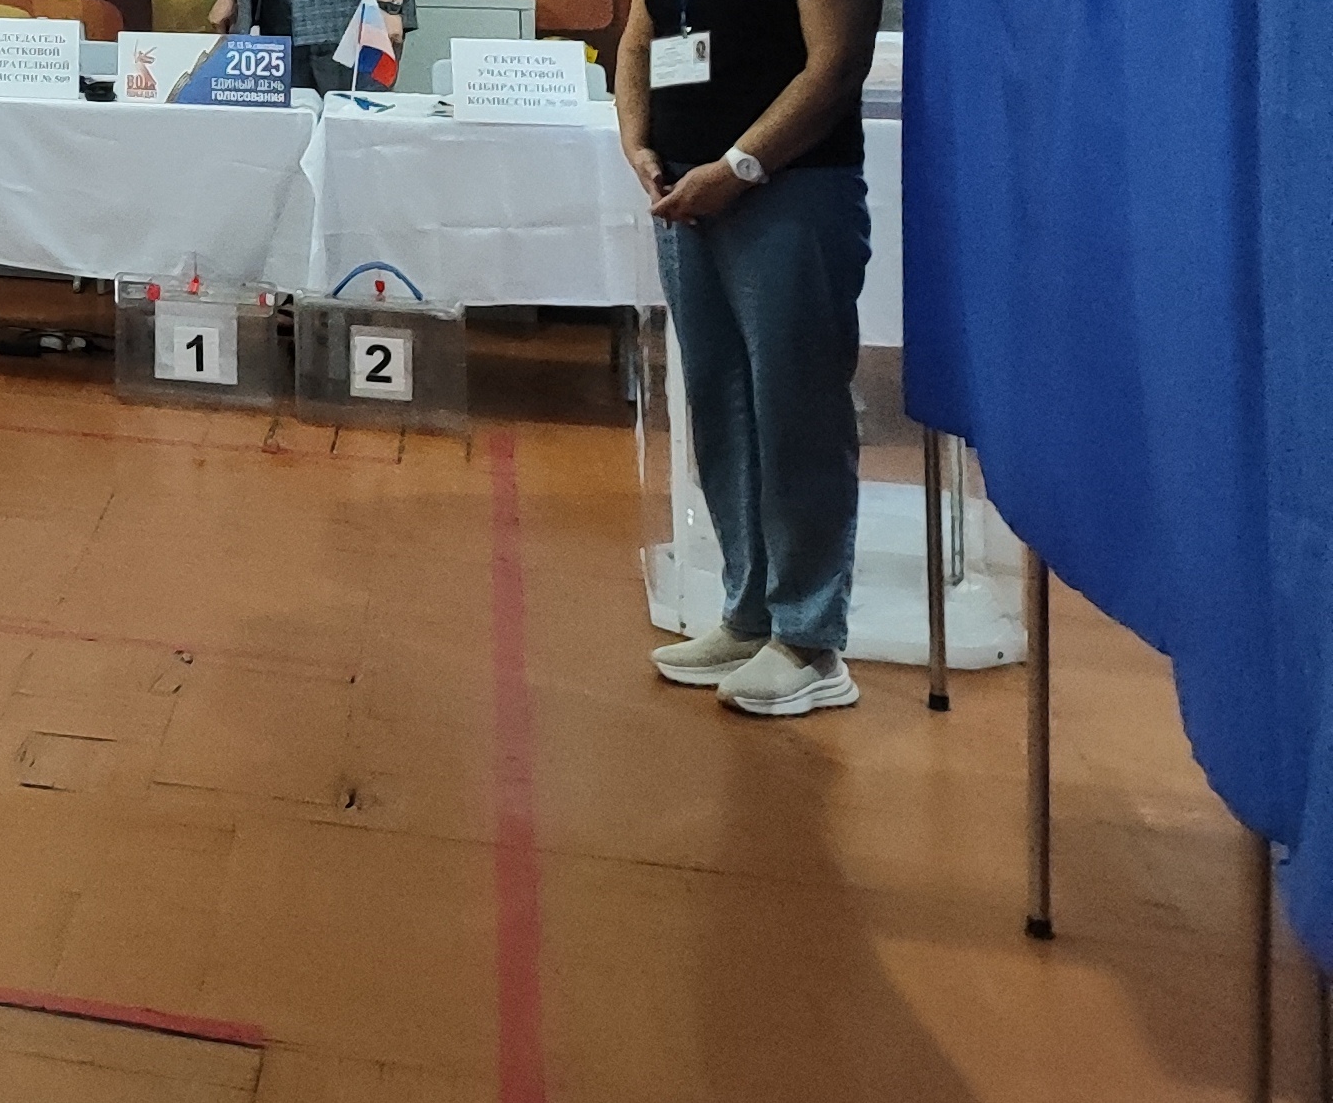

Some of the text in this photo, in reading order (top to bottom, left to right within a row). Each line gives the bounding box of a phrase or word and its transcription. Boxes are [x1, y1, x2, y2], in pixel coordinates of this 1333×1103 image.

[225, 50, 285, 77] 2025
[483, 54, 557, 65] СЕКРЕТАРЬ
[477, 68, 565, 79] УЧАСТКОВОЙ
[211, 77, 285, 91] ЕДИНЫЙ ДЕНЬ
[185, 334, 204, 372] 1
[365, 344, 393, 384] 2
